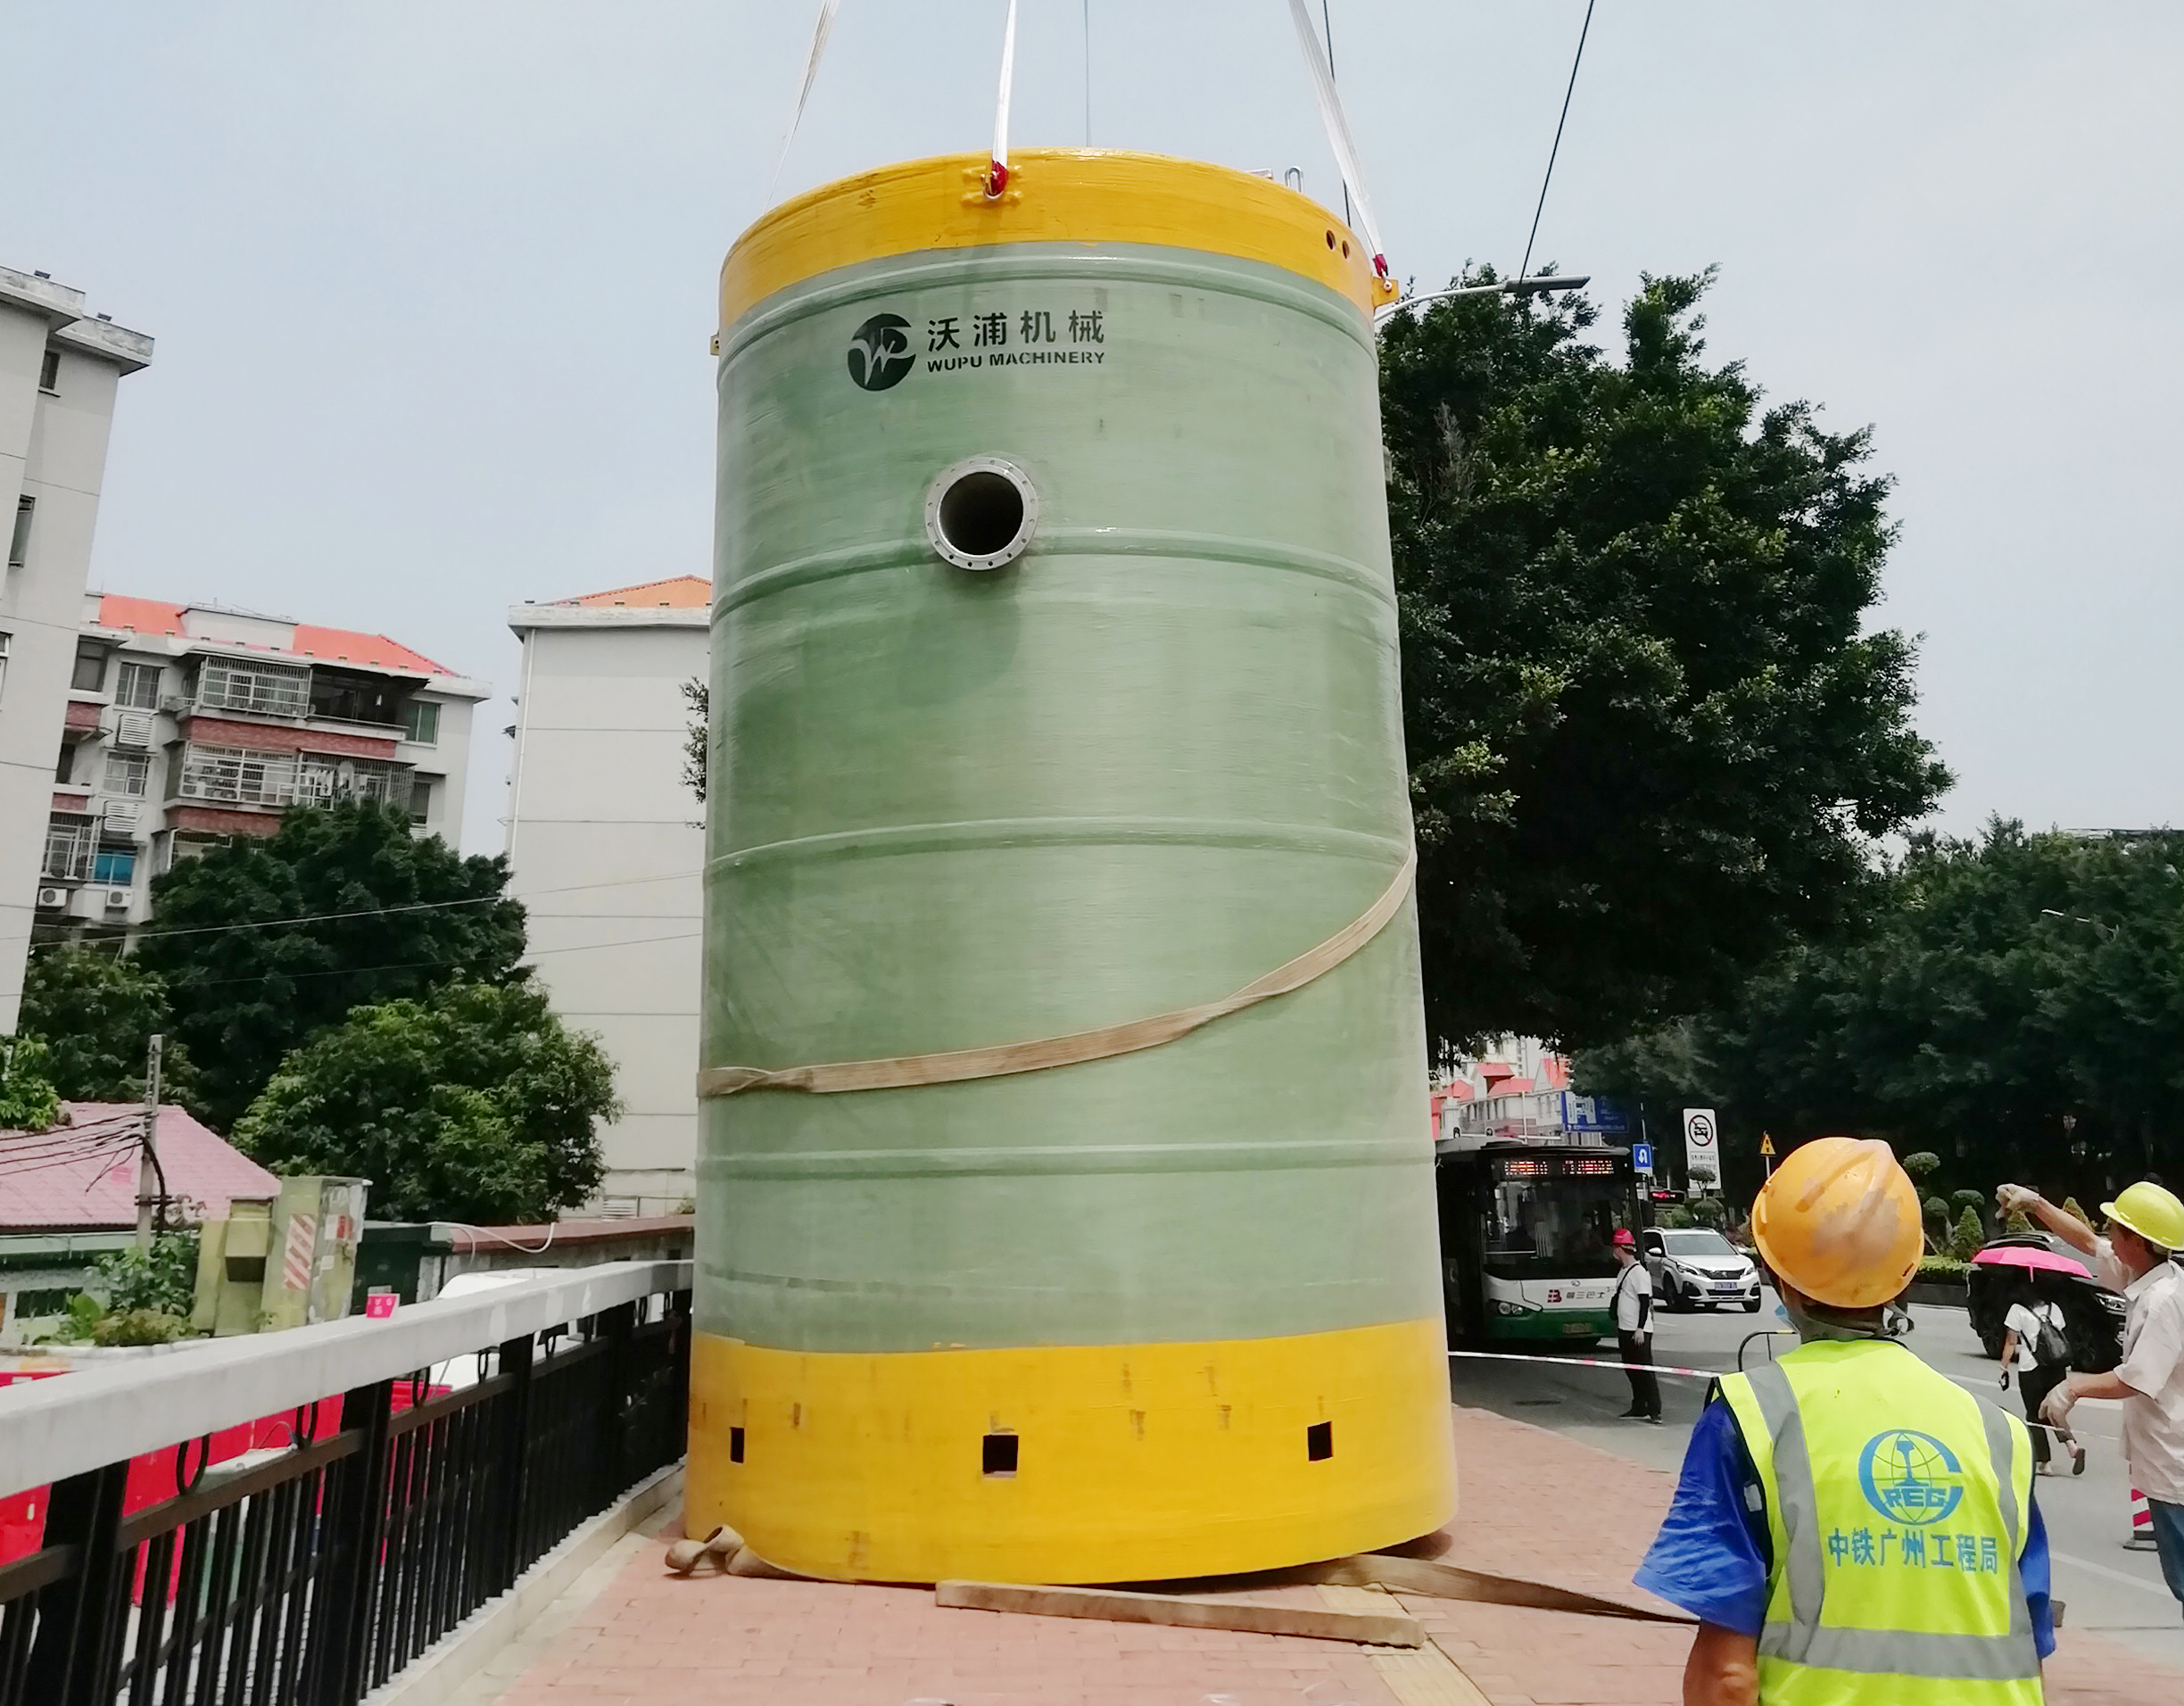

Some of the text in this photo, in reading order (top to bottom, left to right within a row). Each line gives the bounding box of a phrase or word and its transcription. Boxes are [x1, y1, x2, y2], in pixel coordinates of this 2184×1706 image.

[927, 310, 1104, 352] 沃浦机械
[927, 352, 1105, 373] WUPU MACHINERY
[1827, 1527, 1998, 1575] 中铁广州工程局
